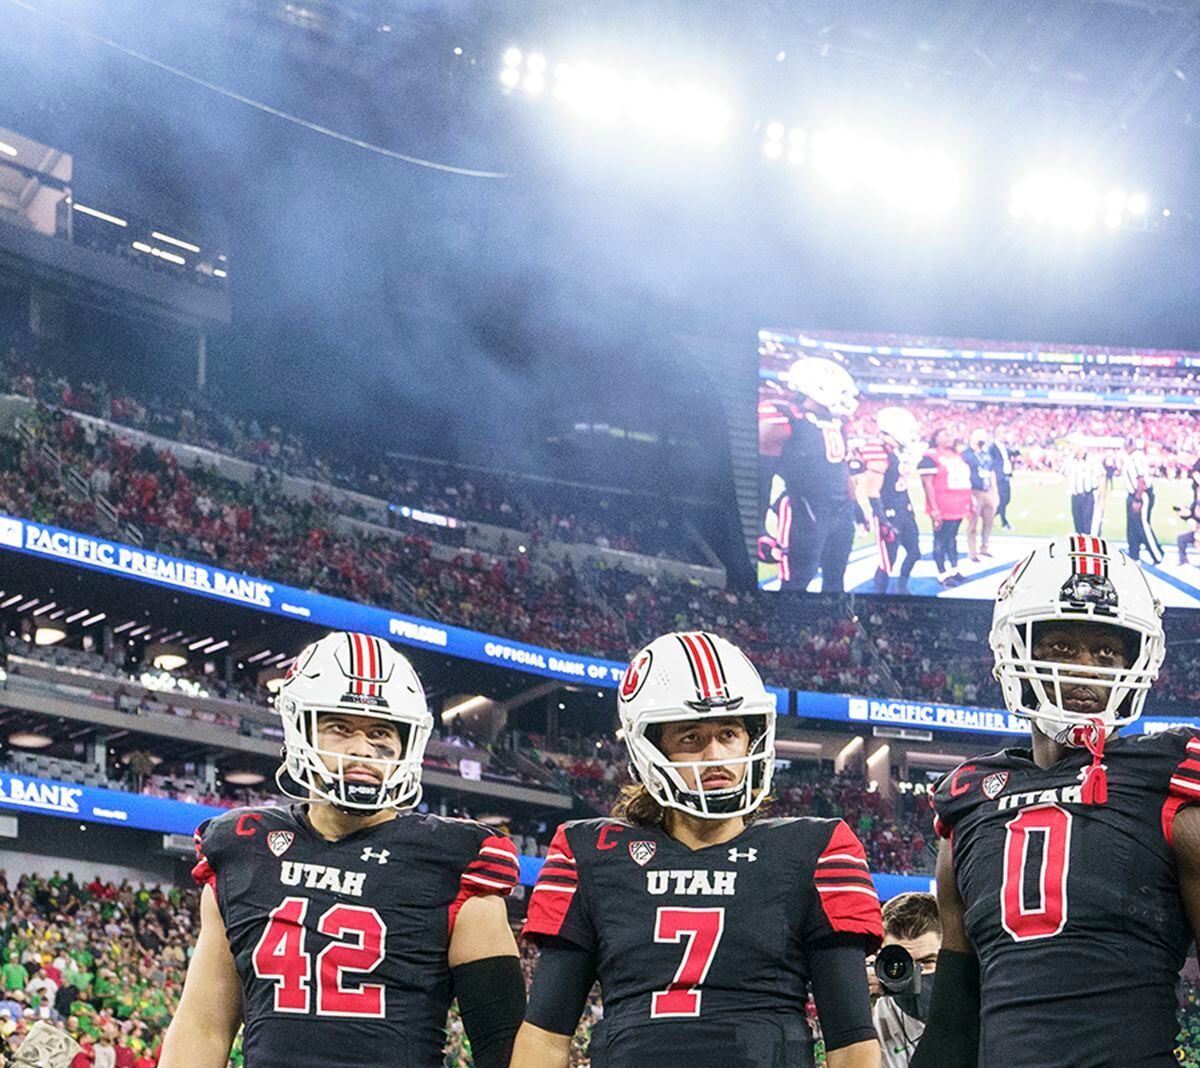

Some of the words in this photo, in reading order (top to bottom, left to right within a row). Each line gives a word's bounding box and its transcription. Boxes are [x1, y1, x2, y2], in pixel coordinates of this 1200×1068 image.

[26, 525, 115, 564] PACIFIC
[119, 548, 210, 590] PREMIER
[214, 571, 272, 604] BANK
[484, 642, 546, 669] OFFICIAL
[549, 659, 585, 677] BANK
[869, 700, 933, 721] PACIFIC
[936, 707, 1004, 729] PREMIER
[10, 779, 79, 808] BANK
[951, 765, 976, 796] C
[235, 813, 263, 836] C
[596, 826, 625, 850] C
[280, 860, 367, 896] UTAH
[646, 870, 737, 895] UTAH
[1000, 802, 1073, 942] 0
[252, 897, 387, 1018] 42
[650, 906, 725, 1018] 7
